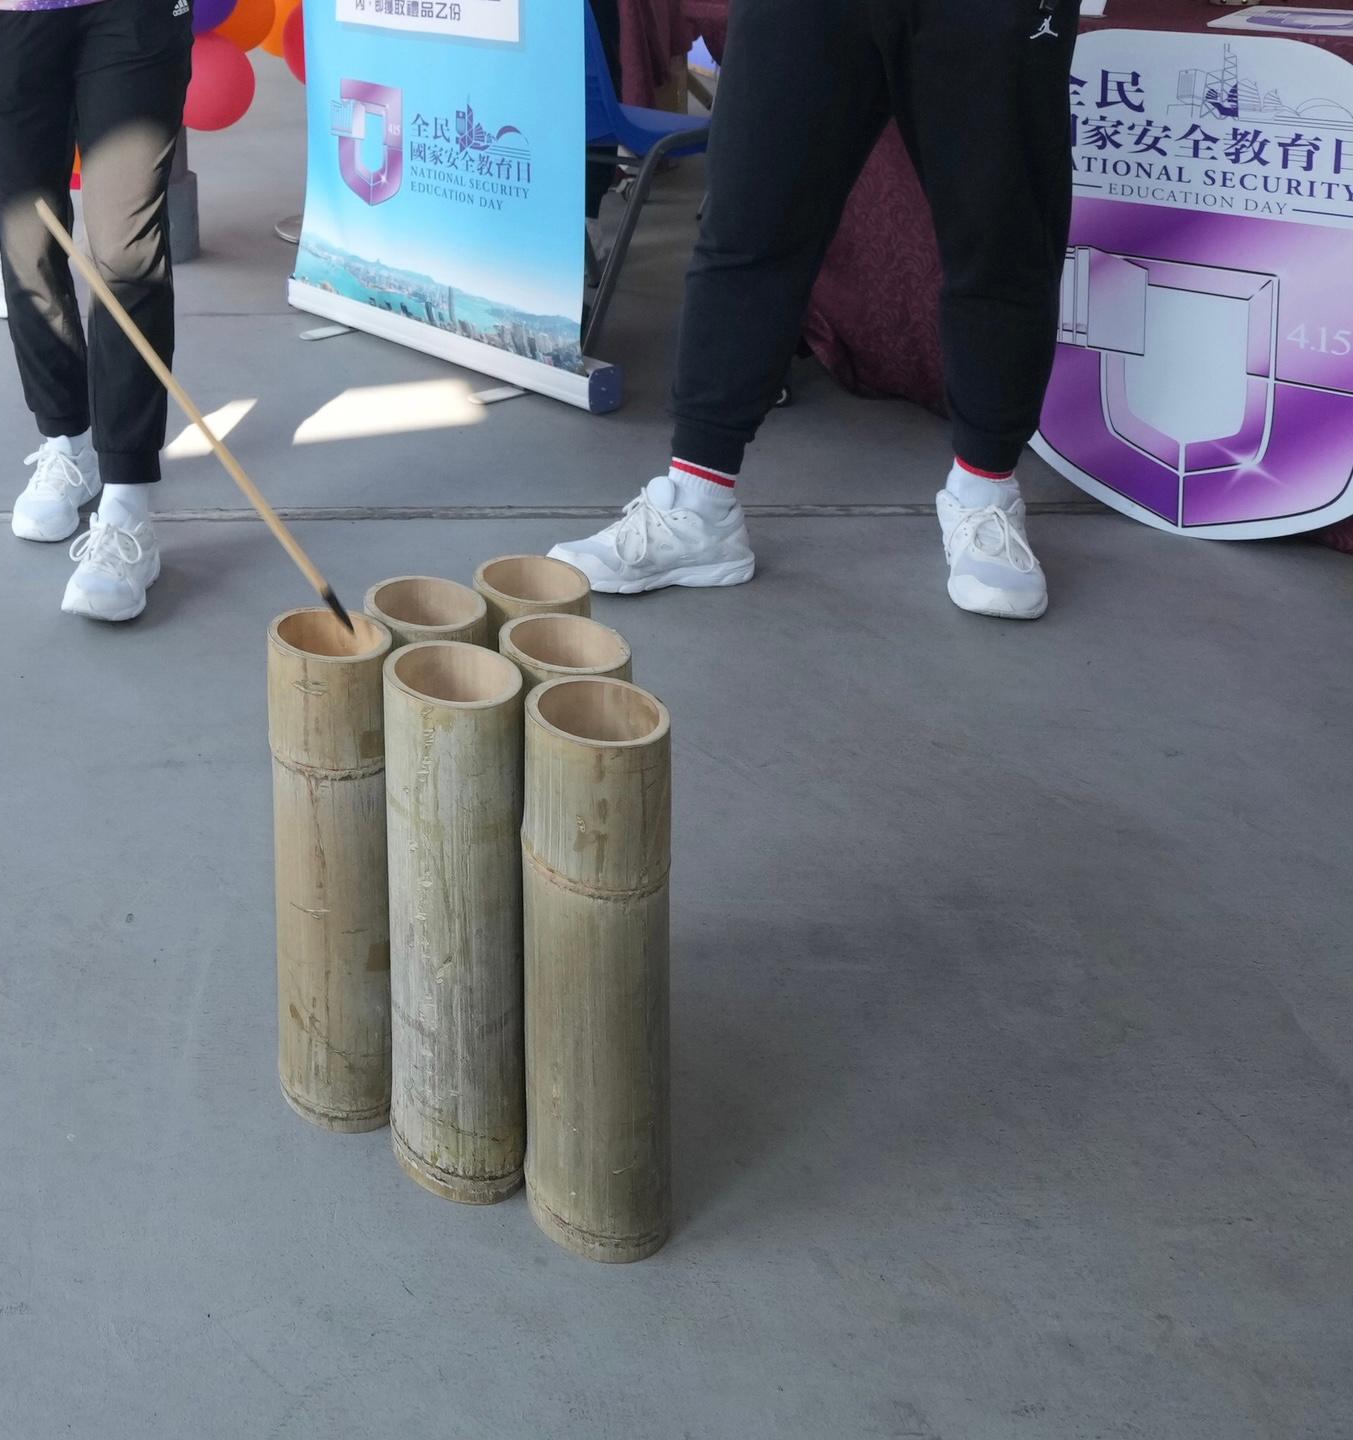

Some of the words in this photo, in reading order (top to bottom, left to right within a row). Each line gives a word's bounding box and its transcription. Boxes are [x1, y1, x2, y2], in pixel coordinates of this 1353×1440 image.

[410, 113, 451, 143] 全民
[1070, 113, 1353, 175] 家安全教育
[410, 141, 532, 184] 國家安全教育日
[1072, 154, 1191, 184] TIONAL
[1203, 169, 1353, 202] SECURITY
[410, 165, 466, 186] NATIONAL
[469, 178, 530, 200] SECURITY
[410, 180, 474, 205] EDUCATION
[479, 196, 504, 210] DAY
[1108, 183, 1234, 208] EDUCATION
[1244, 198, 1288, 215] DAY
[1287, 323, 1352, 356] 4.15
